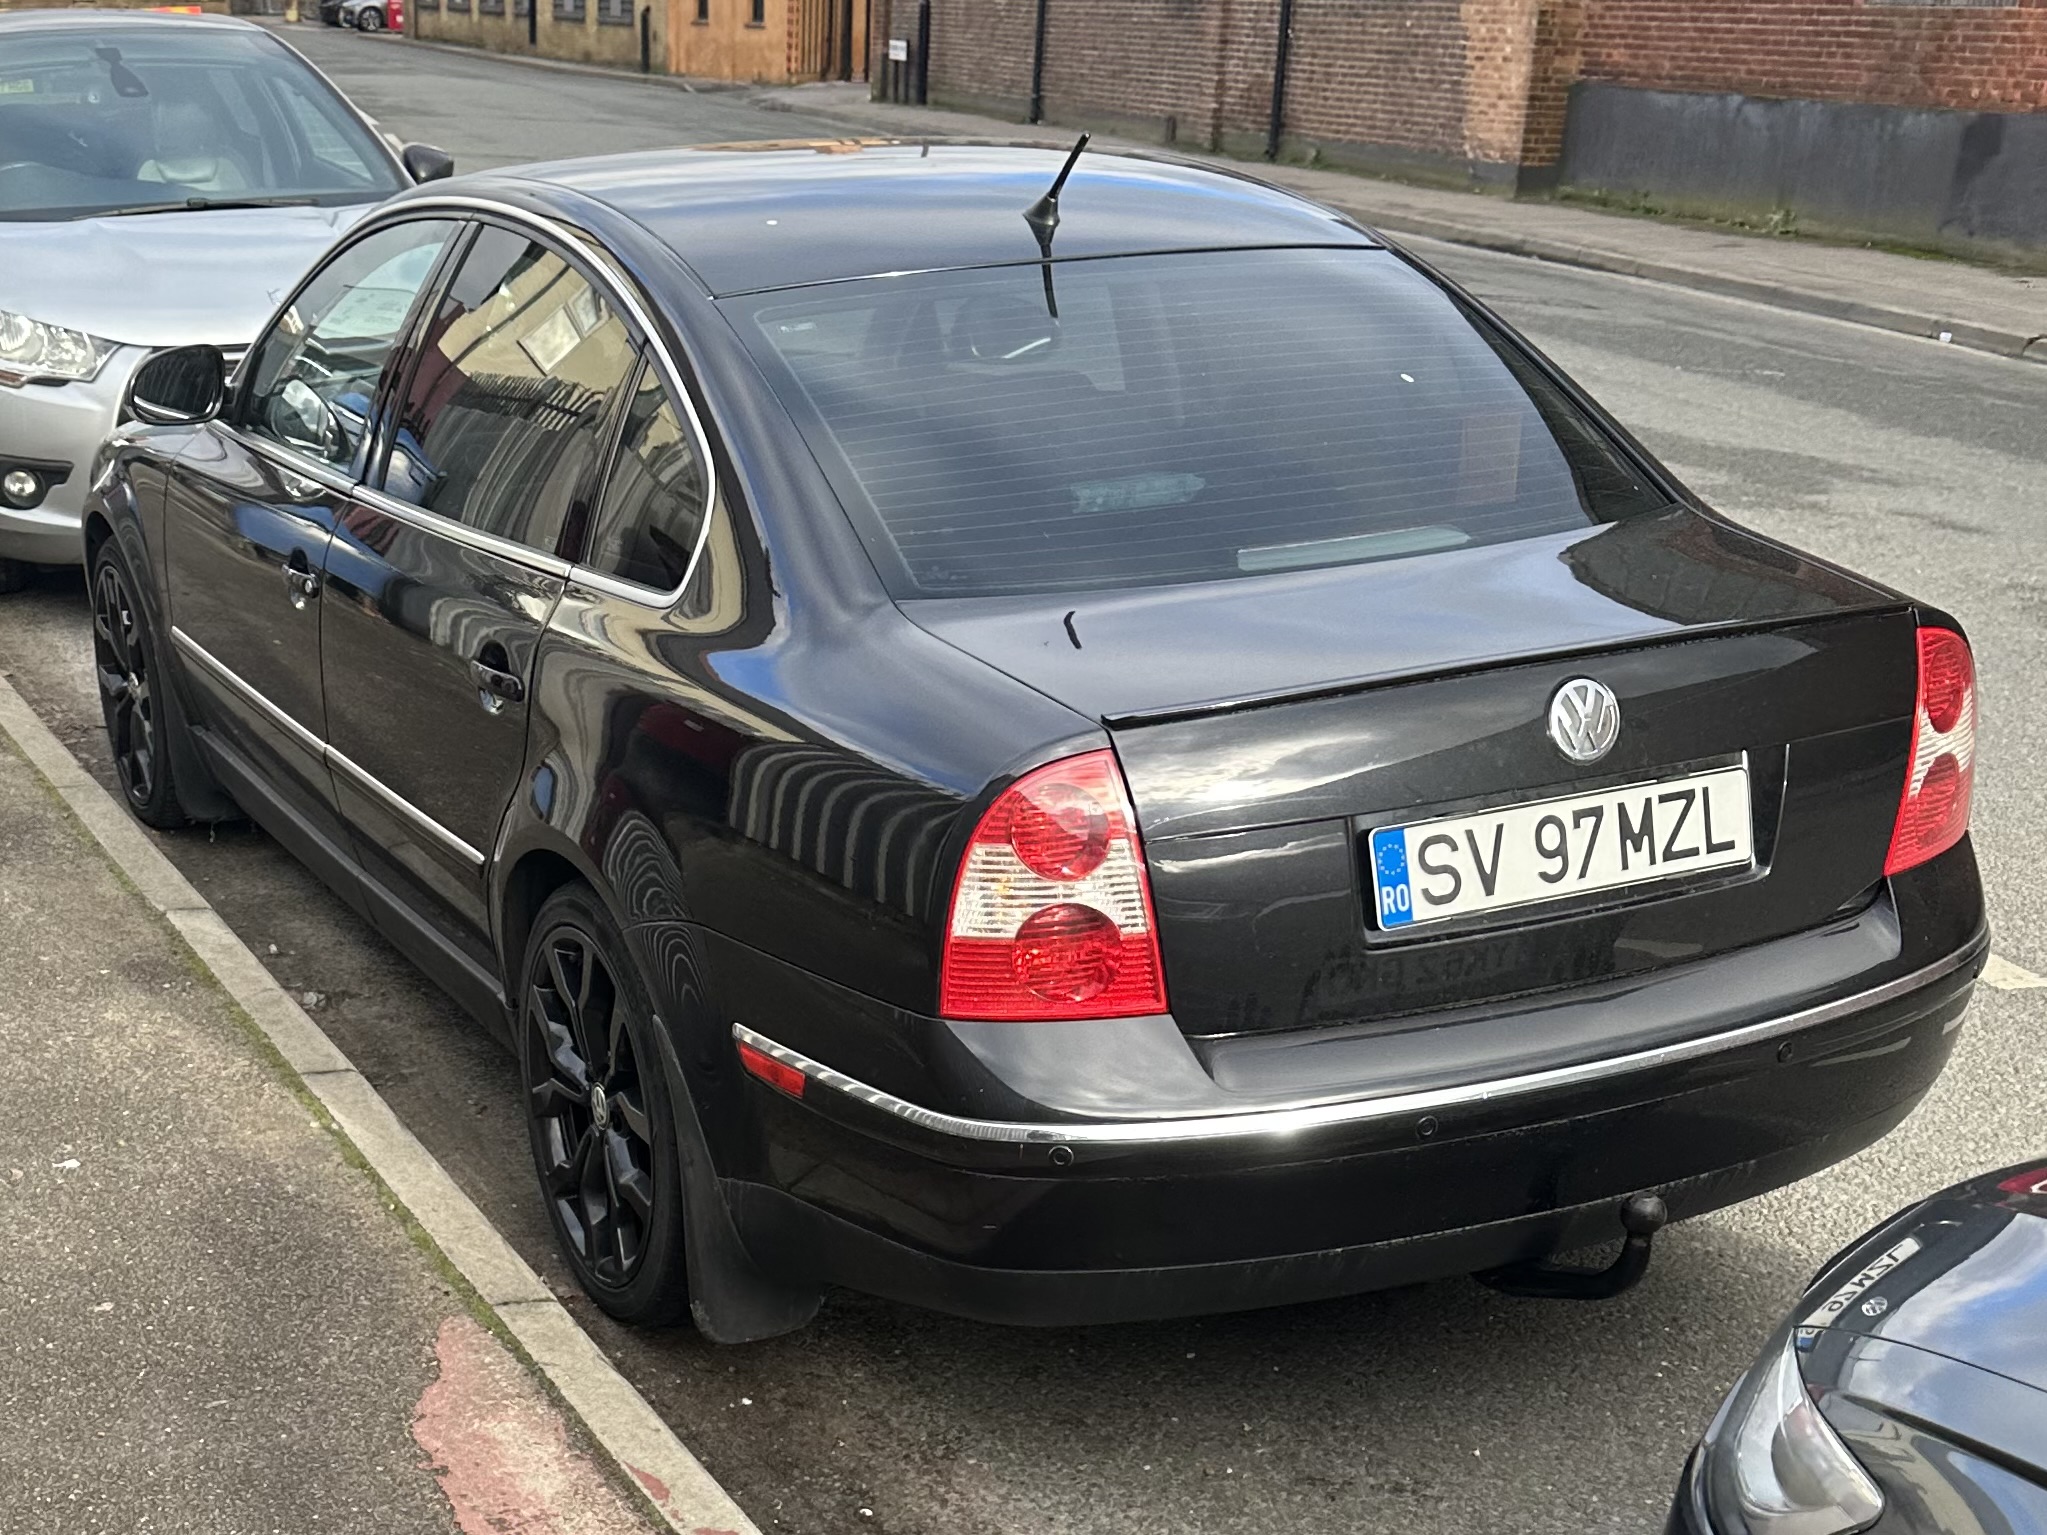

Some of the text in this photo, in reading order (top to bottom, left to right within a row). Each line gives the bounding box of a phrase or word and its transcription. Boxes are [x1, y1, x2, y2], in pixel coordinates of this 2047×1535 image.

[1550, 678, 1620, 764] VW
[1418, 786, 1736, 906] SV 97 MZL
[1381, 883, 1410, 916] RO
